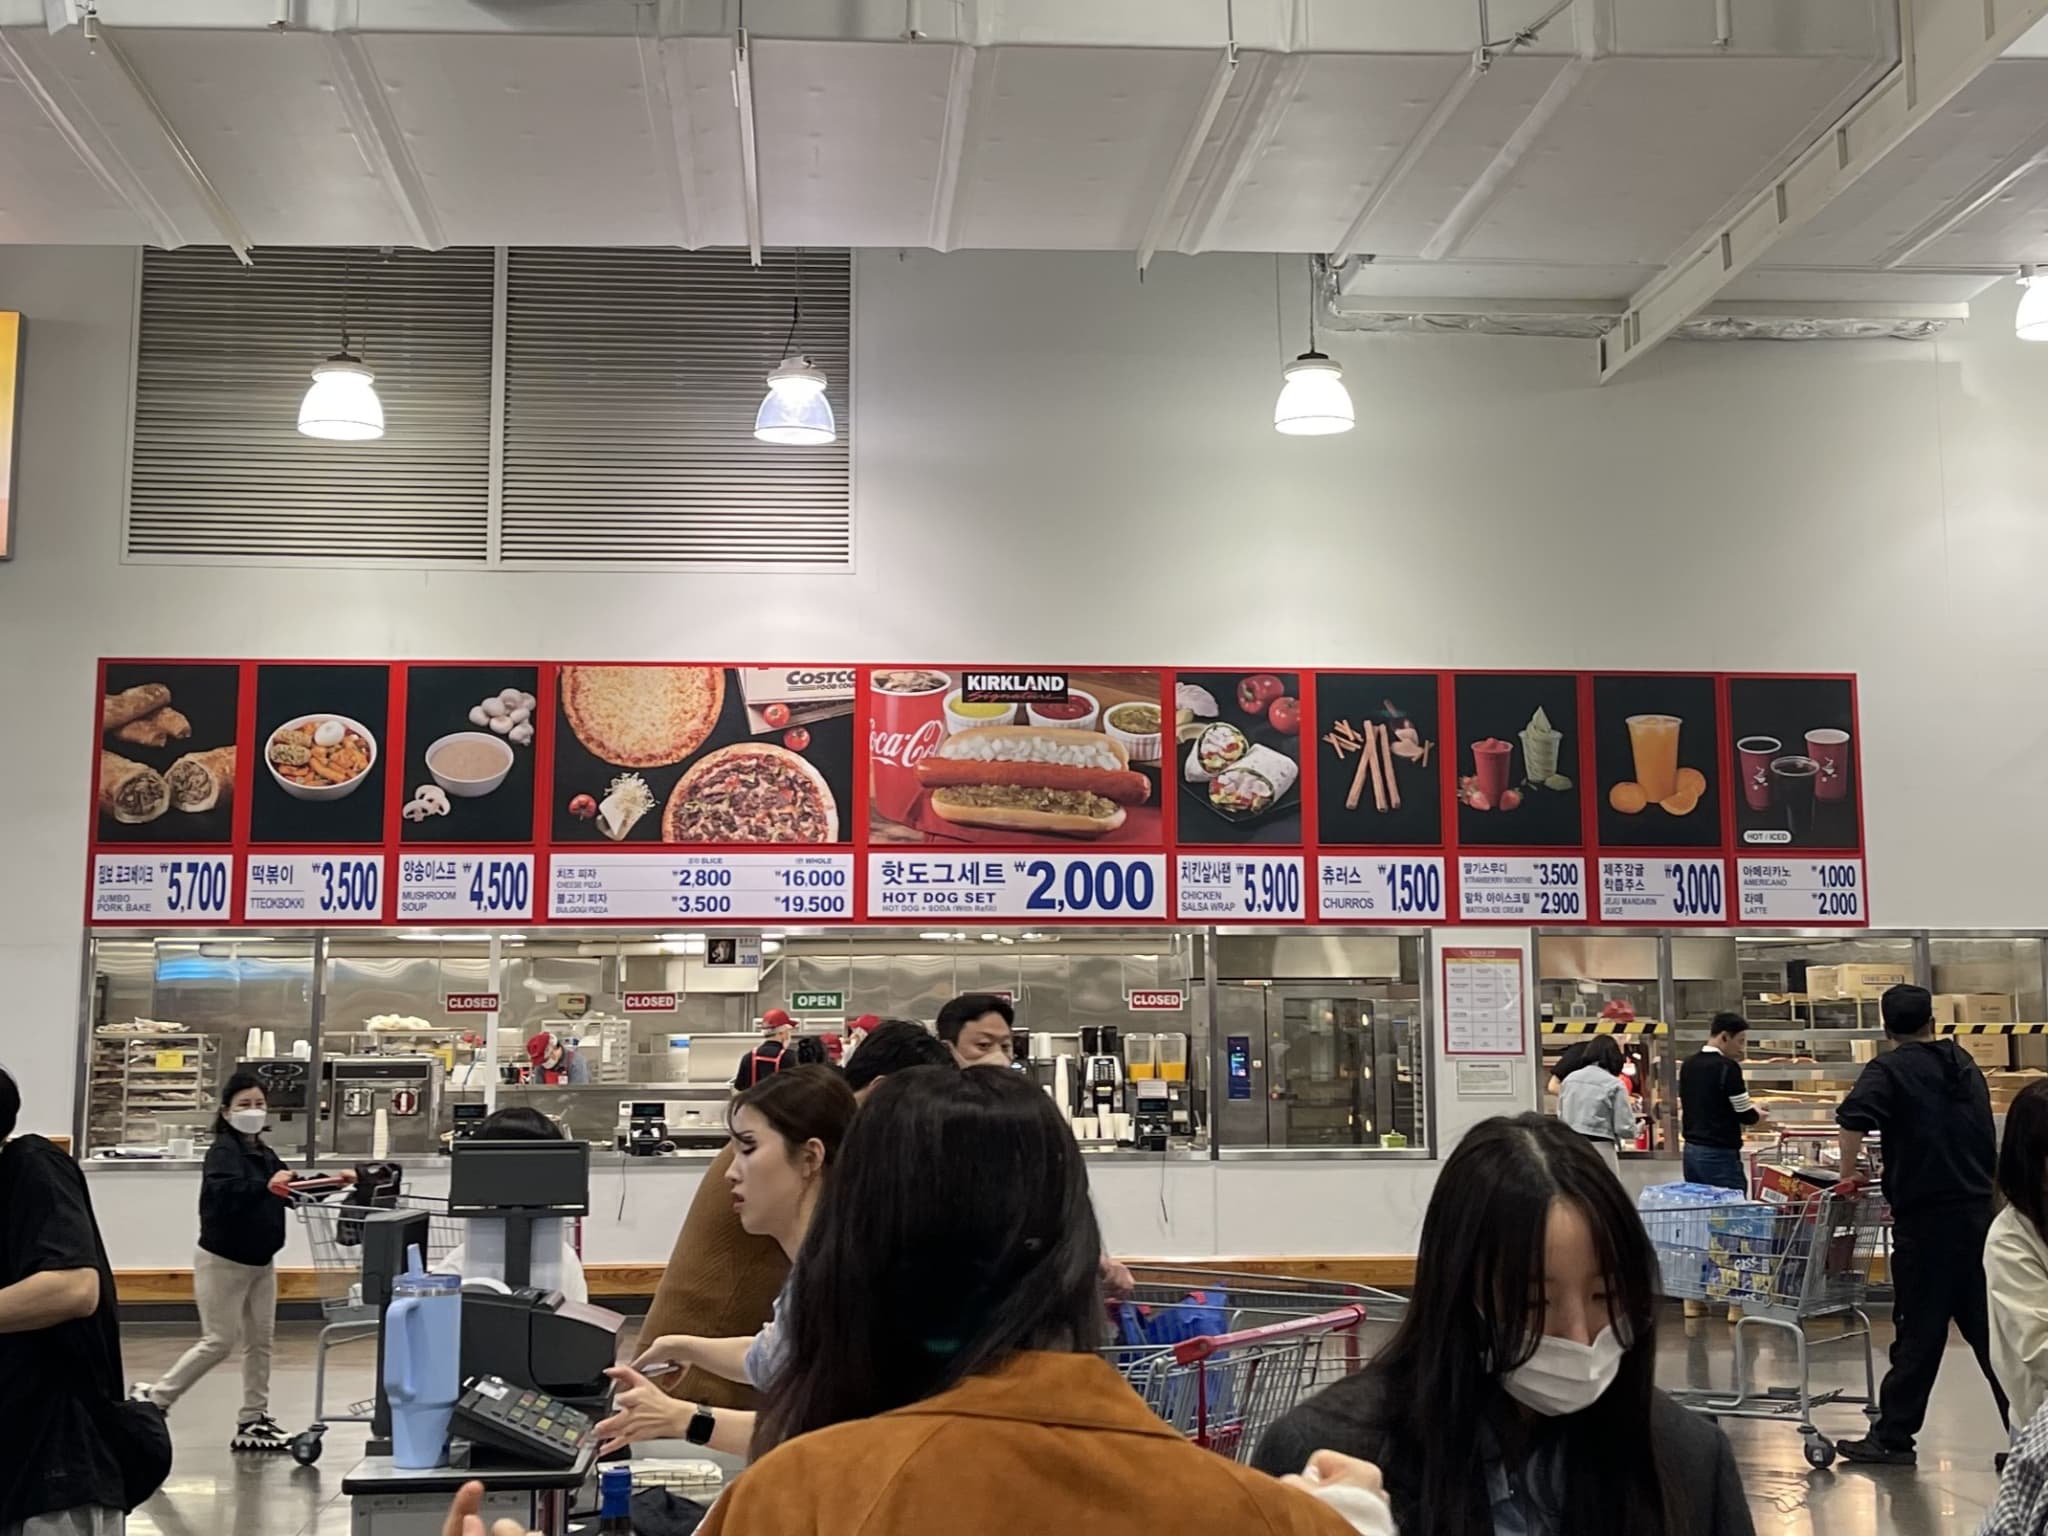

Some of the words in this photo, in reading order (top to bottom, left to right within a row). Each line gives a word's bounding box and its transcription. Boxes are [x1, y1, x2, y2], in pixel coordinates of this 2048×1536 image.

[968, 675, 1064, 691] KIRKLAND
[252, 864, 293, 884] 떡볶이
[403, 860, 456, 881] 양송이스프
[881, 861, 1005, 885] 핫도그세트
[1322, 865, 1362, 885] 츄러스
[1604, 863, 1644, 876] 제주감귤
[1743, 865, 1791, 877] 아메리카노
[402, 891, 456, 900] MUSHROOM
[882, 892, 917, 903] HOT
[923, 892, 958, 903] DOG
[964, 892, 996, 903] SET
[1181, 891, 1221, 900] CHICKEN
[1486, 892, 1530, 904] 아이스크림
[97, 903, 121, 911] PORK
[126, 903, 151, 911] BAKE
[402, 902, 427, 911] SOUP
[1181, 902, 1209, 911] SALSA
[1211, 902, 1236, 911] WRAP
[1323, 898, 1374, 909] CHURROS
[1745, 906, 1768, 914] LATTE
[449, 997, 497, 1008] CLOSED
[626, 995, 674, 1007] CLOSED
[798, 995, 837, 1007] OPEN
[1133, 995, 1179, 1006] CLOSED
